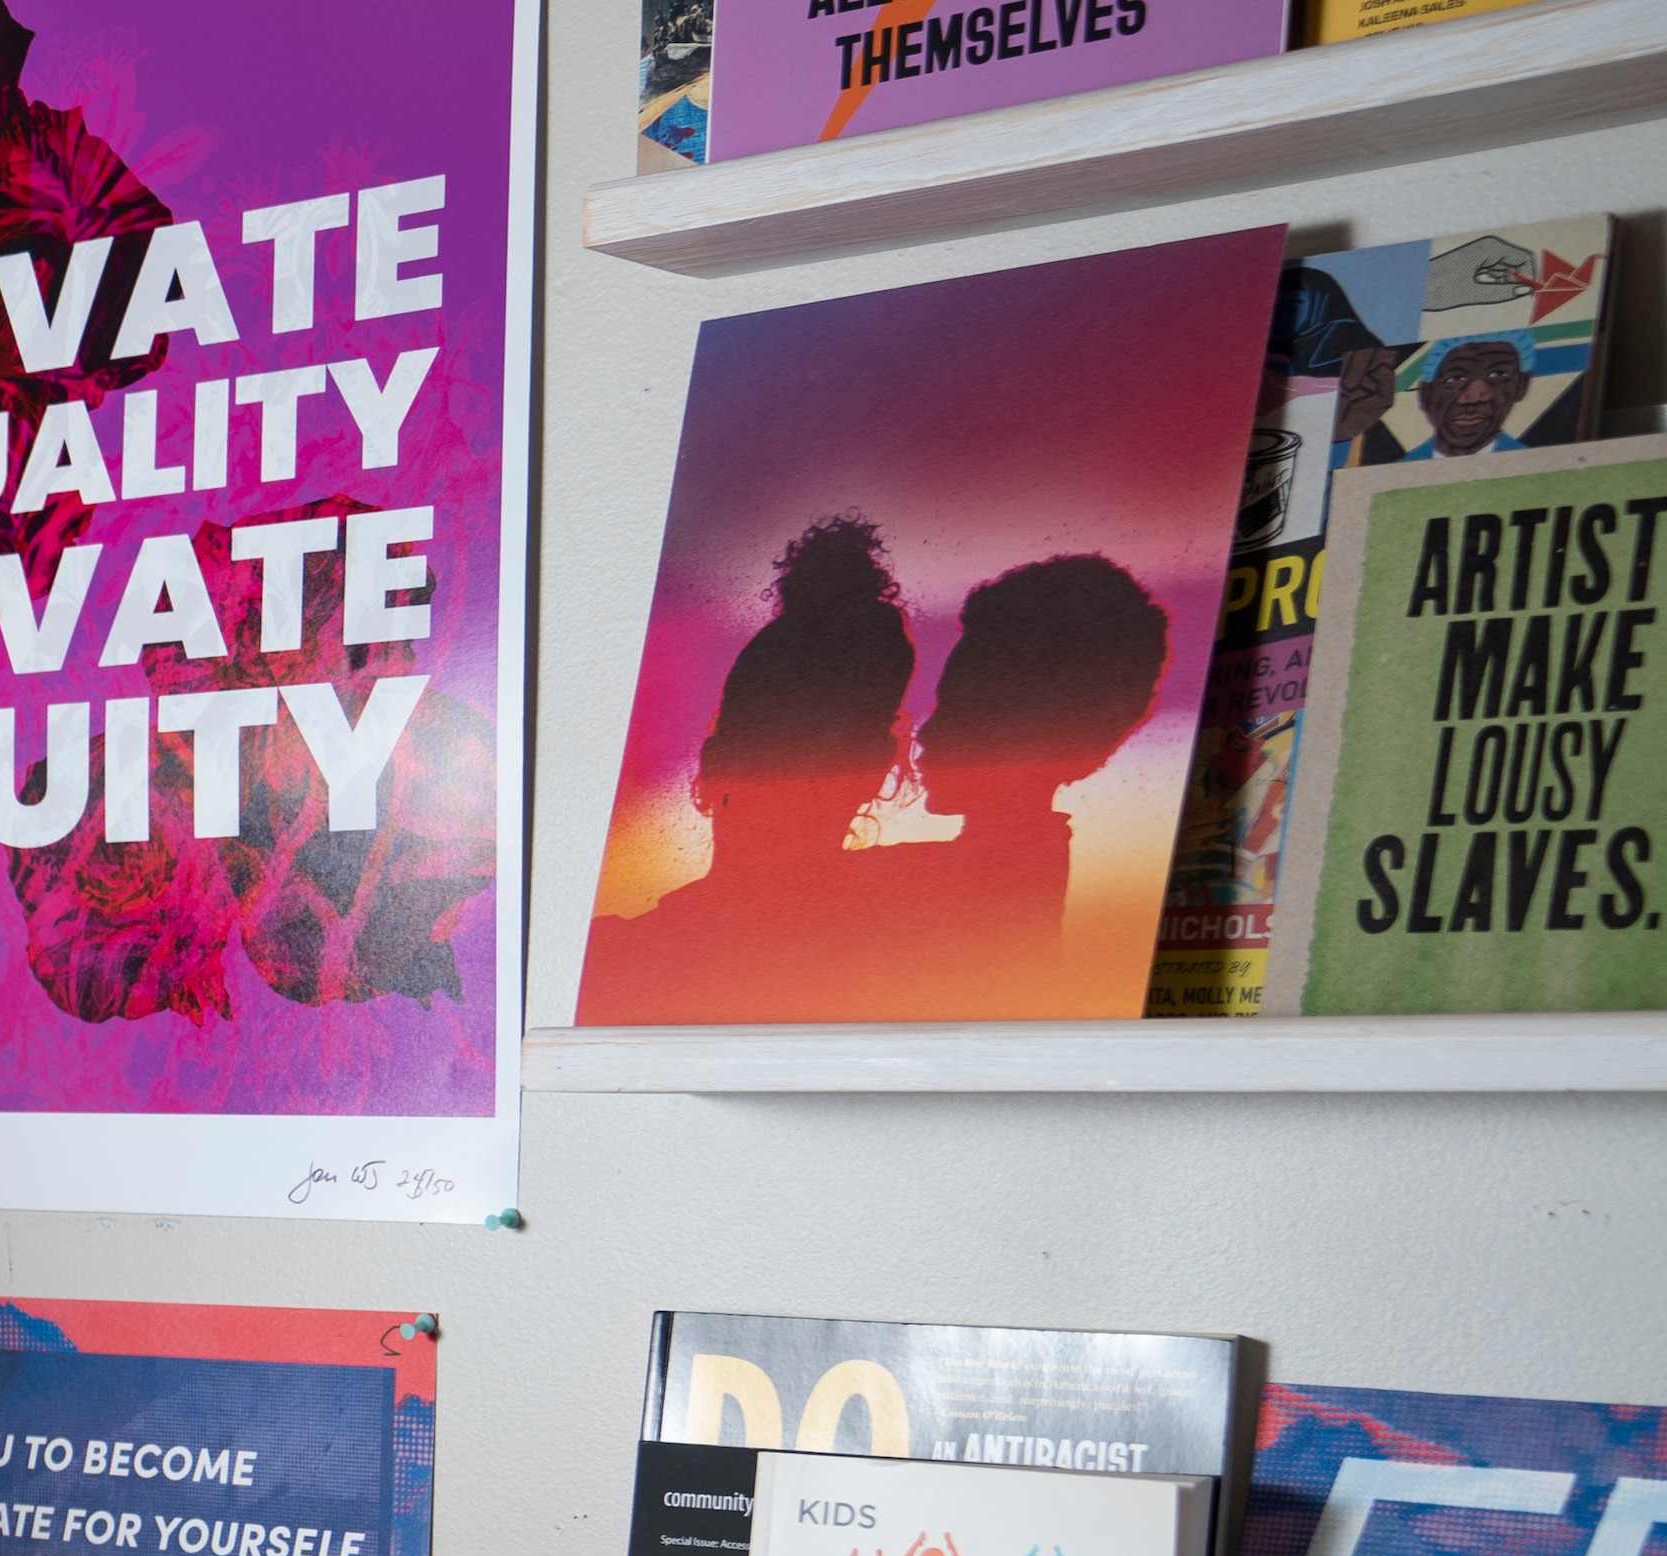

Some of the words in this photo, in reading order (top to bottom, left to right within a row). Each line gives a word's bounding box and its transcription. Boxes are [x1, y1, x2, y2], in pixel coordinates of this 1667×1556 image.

[835, 0, 1146, 91] THEMSELVES
[1407, 496, 1667, 618] ARTIST
[1433, 607, 1656, 721] MAKE
[1427, 718, 1626, 828] LOUSY
[1356, 826, 1661, 934] SLAVES.
[1183, 985, 1235, 1005] MOLLY
[25, 1435, 74, 1473] TO
[83, 1440, 258, 1487] BECOME
[932, 1440, 957, 1461] AN
[963, 1433, 1150, 1473] ANTIRACIST
[663, 1491, 755, 1517] community
[797, 1498, 878, 1531] KIDS
[63, 1508, 143, 1548] FOR
[660, 1534, 692, 1547] Special
[694, 1536, 719, 1549] Issue:
